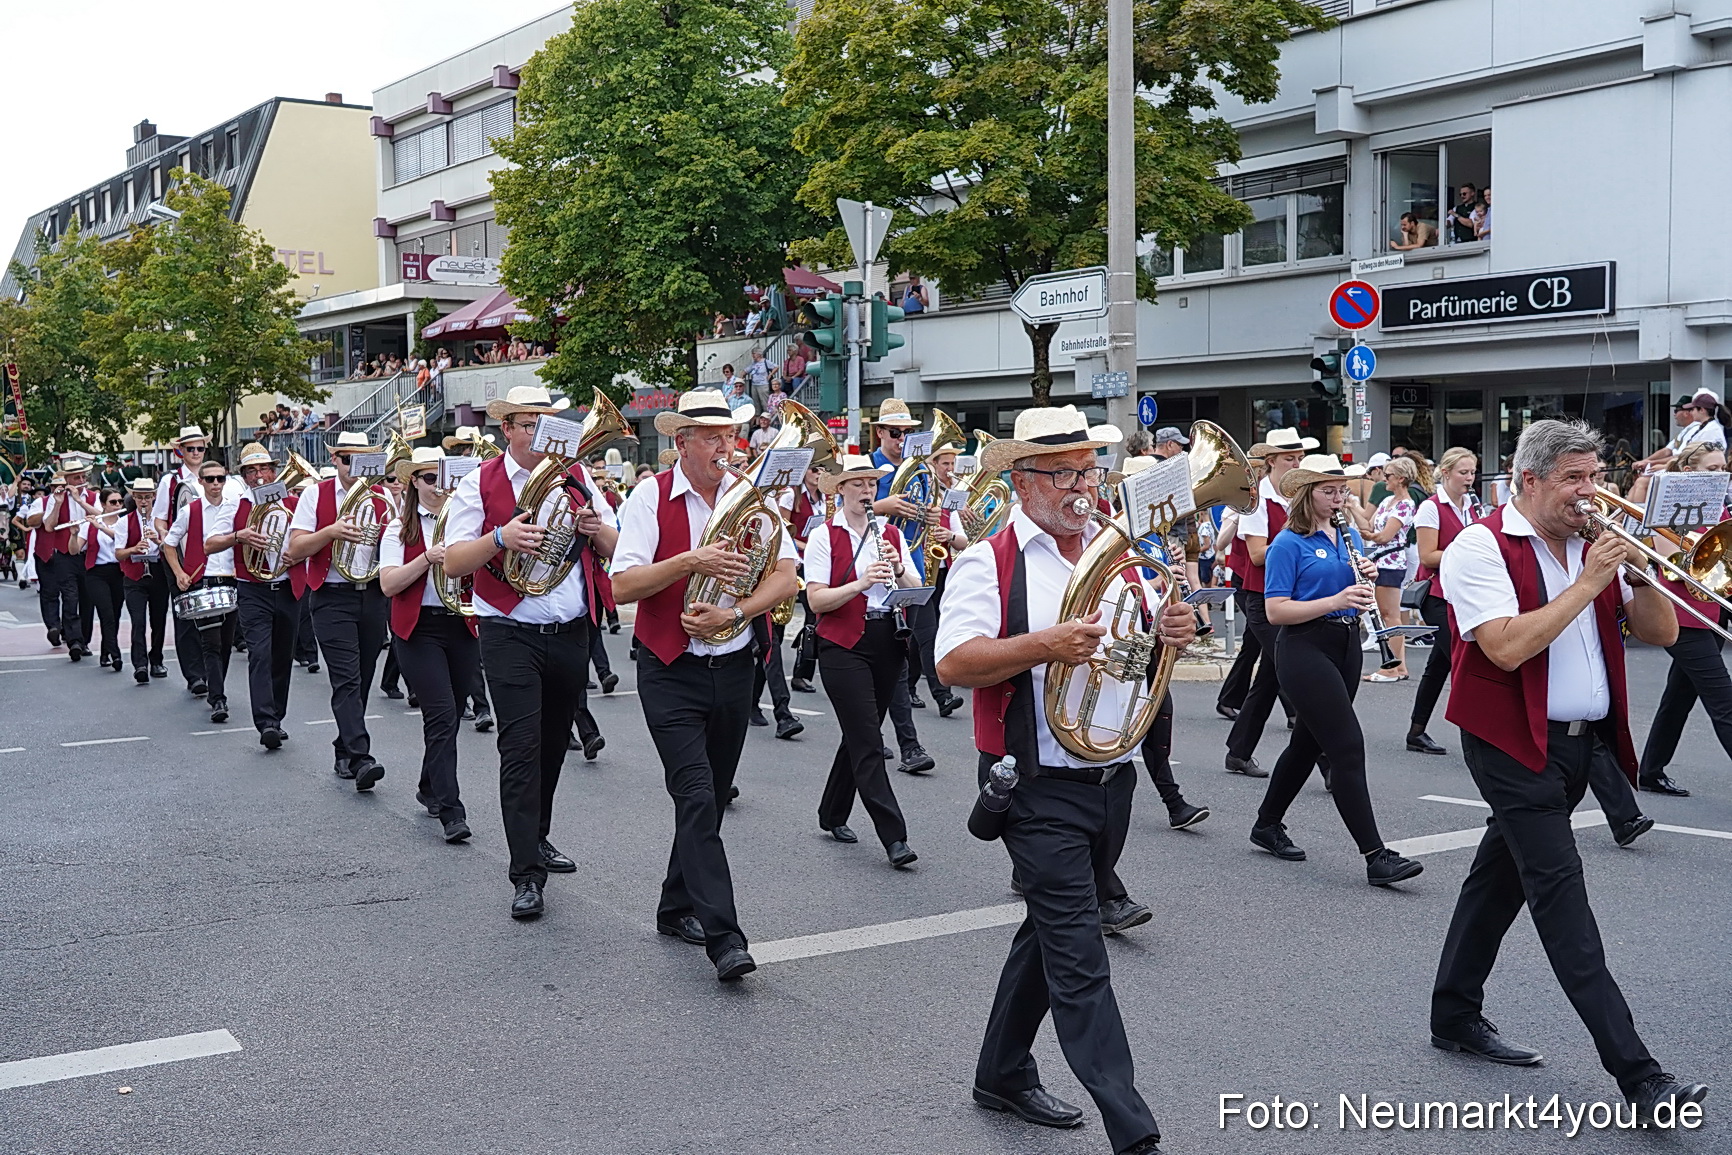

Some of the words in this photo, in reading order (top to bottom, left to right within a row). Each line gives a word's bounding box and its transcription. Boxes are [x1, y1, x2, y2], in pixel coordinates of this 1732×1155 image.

[271, 249, 335, 275] TEL
[1385, 258, 1400, 266] Museen
[1040, 285, 1089, 307] Bahnhof
[1409, 290, 1518, 320] Parfümerie
[1528, 276, 1572, 309] CB
[1061, 336, 1107, 351] Bahnhofstraße
[629, 389, 680, 415] Apothe
[1402, 388, 1418, 403] CB
